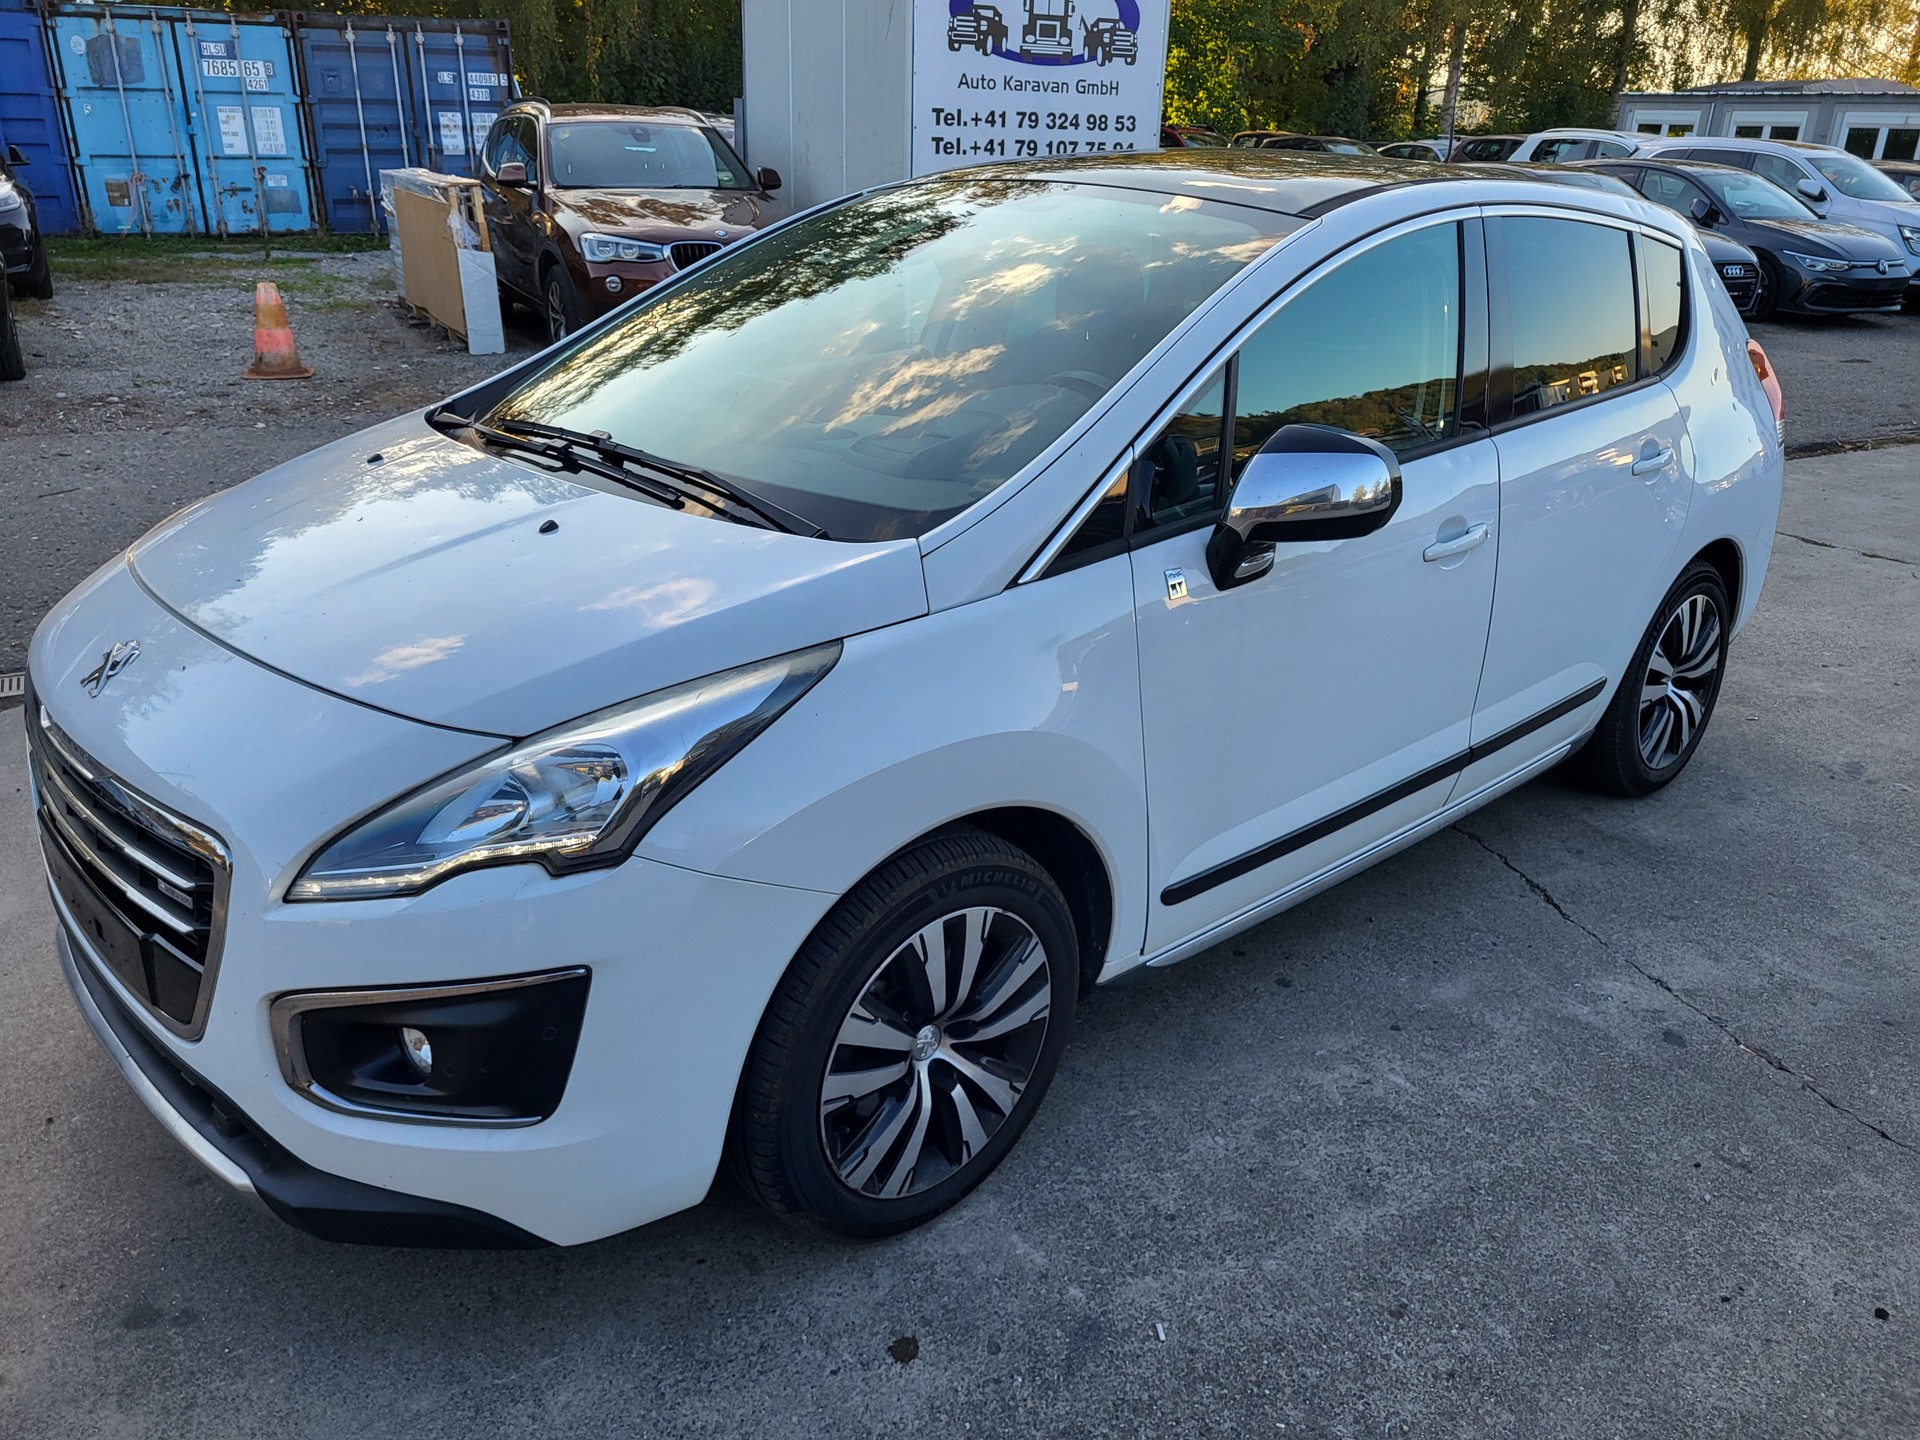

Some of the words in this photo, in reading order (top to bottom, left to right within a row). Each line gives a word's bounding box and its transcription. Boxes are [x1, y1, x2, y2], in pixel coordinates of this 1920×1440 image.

[201, 44, 226, 55] HLSU
[203, 60, 237, 76] 7685
[243, 61, 260, 77] 65
[957, 73, 997, 90] Auto
[1003, 75, 1069, 94] Karavan
[1075, 79, 1120, 96] GmbH
[471, 90, 490, 100] 4310
[931, 107, 1006, 128] Tel.+41
[1015, 111, 1040, 129] 79
[1045, 112, 1080, 131] 324
[1086, 113, 1109, 132] 98
[1114, 115, 1137, 133] 53
[931, 137, 1005, 156] Tel.+41
[1014, 139, 1038, 157] 79
[1046, 140, 1079, 155] 107
[961, 871, 1037, 893] MICHELIN
